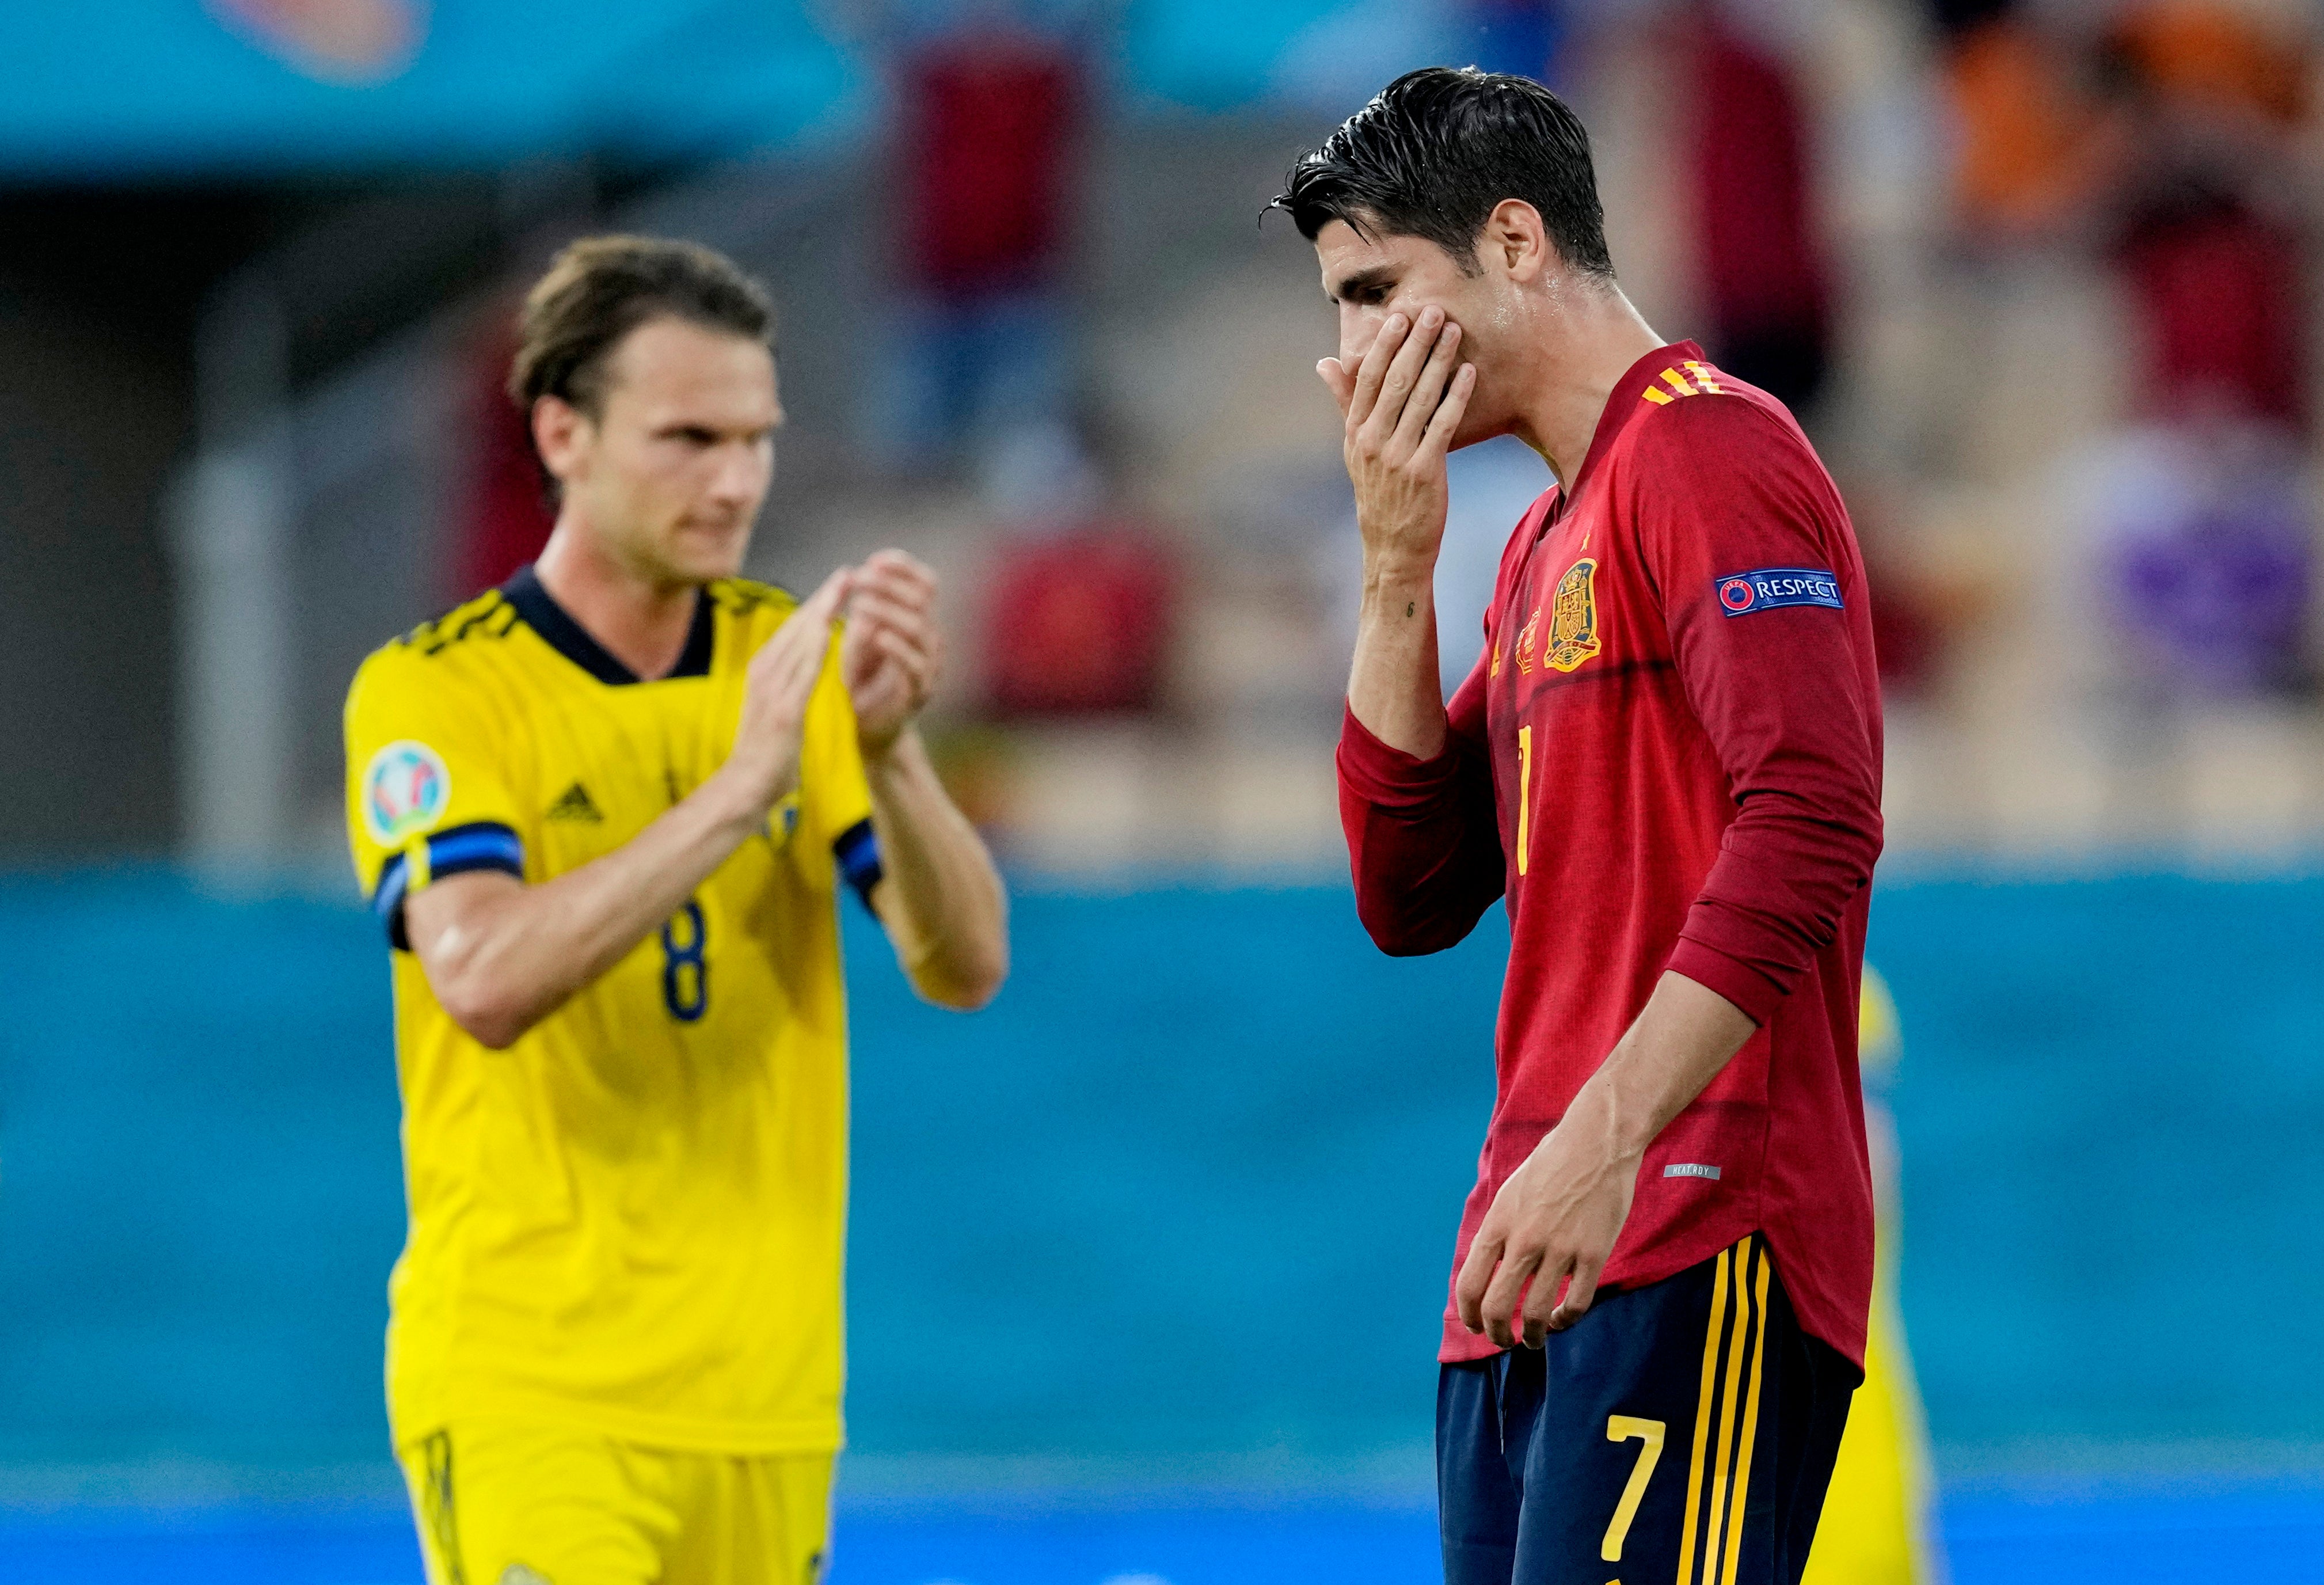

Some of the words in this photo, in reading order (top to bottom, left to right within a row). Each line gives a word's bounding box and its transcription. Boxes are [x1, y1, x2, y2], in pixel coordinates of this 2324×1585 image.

[1724, 581, 1744, 591] UEFA
[1756, 579, 1837, 598] RESPECT
[662, 900, 706, 1021] 8
[1673, 1166, 1709, 1176] HEAT.RDY
[1601, 1415, 1666, 1562] 7
